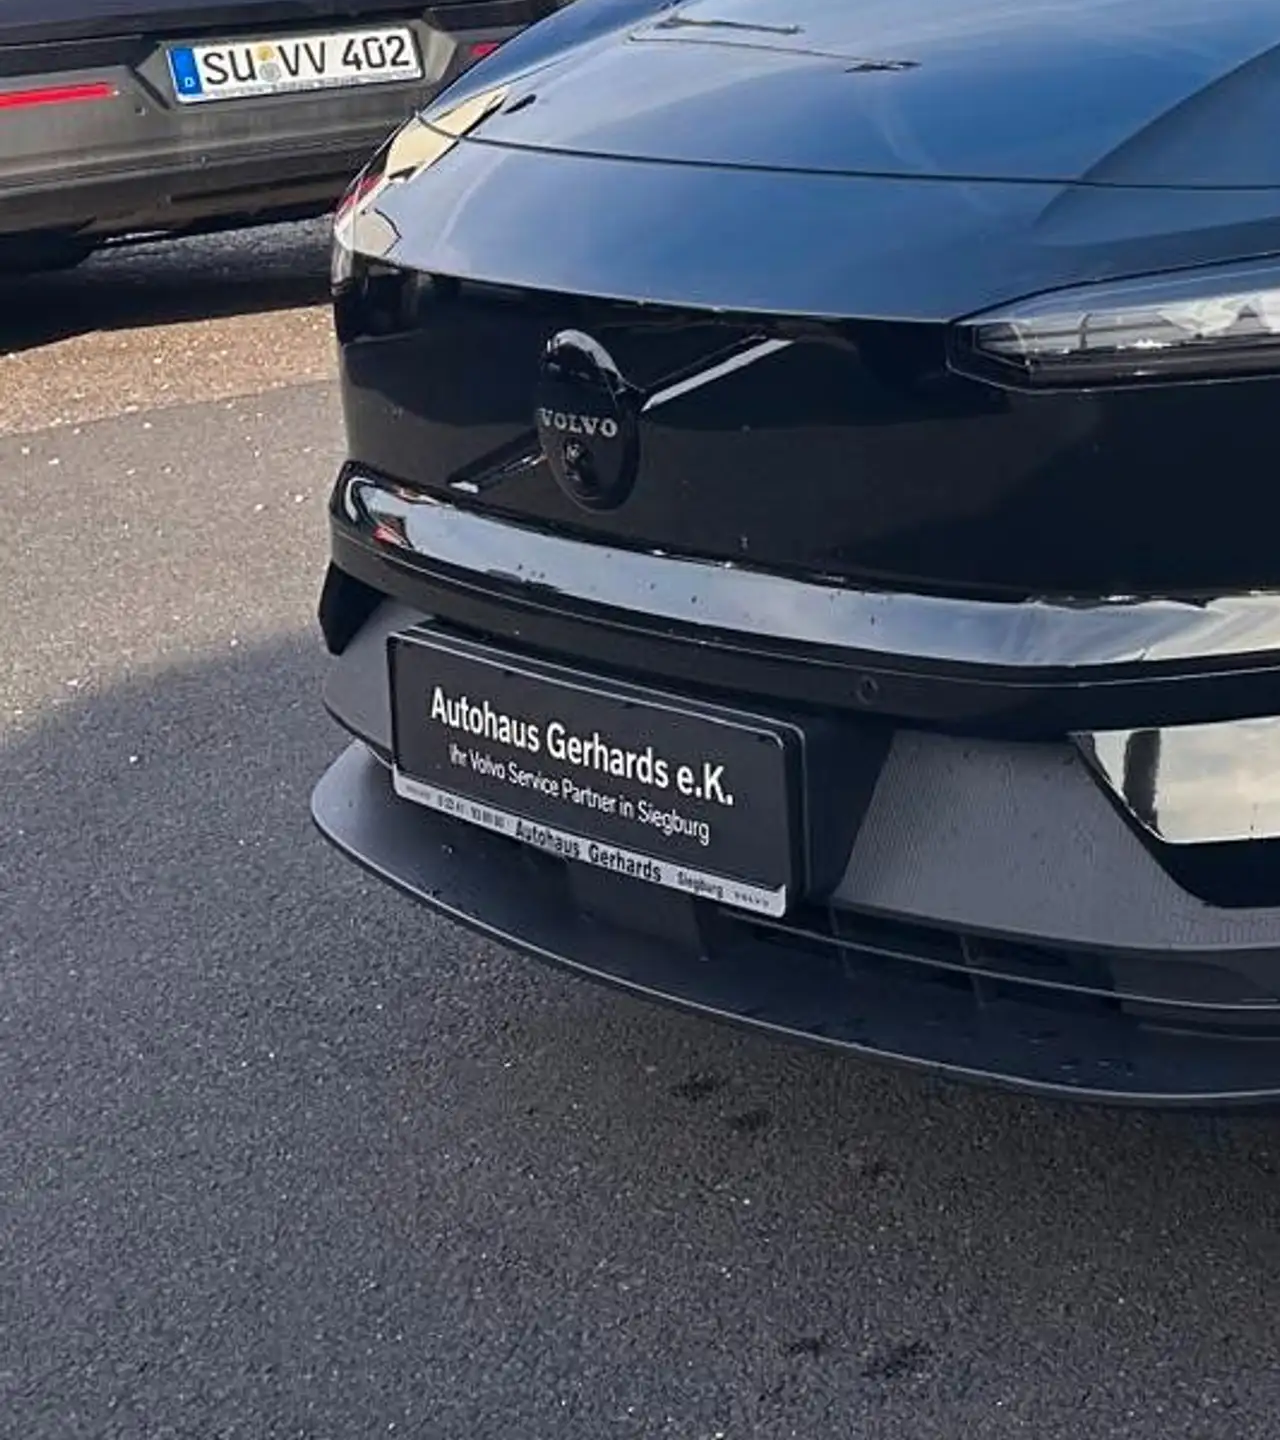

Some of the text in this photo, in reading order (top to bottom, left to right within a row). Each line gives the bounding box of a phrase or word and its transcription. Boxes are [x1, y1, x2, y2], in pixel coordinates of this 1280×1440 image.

[184, 77, 195, 88] D
[203, 47, 257, 85] SU
[278, 41, 326, 77] VV
[341, 35, 410, 71] 402
[538, 408, 618, 438] VOLVO
[431, 686, 734, 806] Autohaus Gerhards e.K.
[449, 743, 710, 846] Ihr Volvo Service Partner in Siegburg
[516, 820, 580, 858] Autohaus
[588, 844, 662, 882] Gerhards
[676, 871, 724, 900] Siegburg
